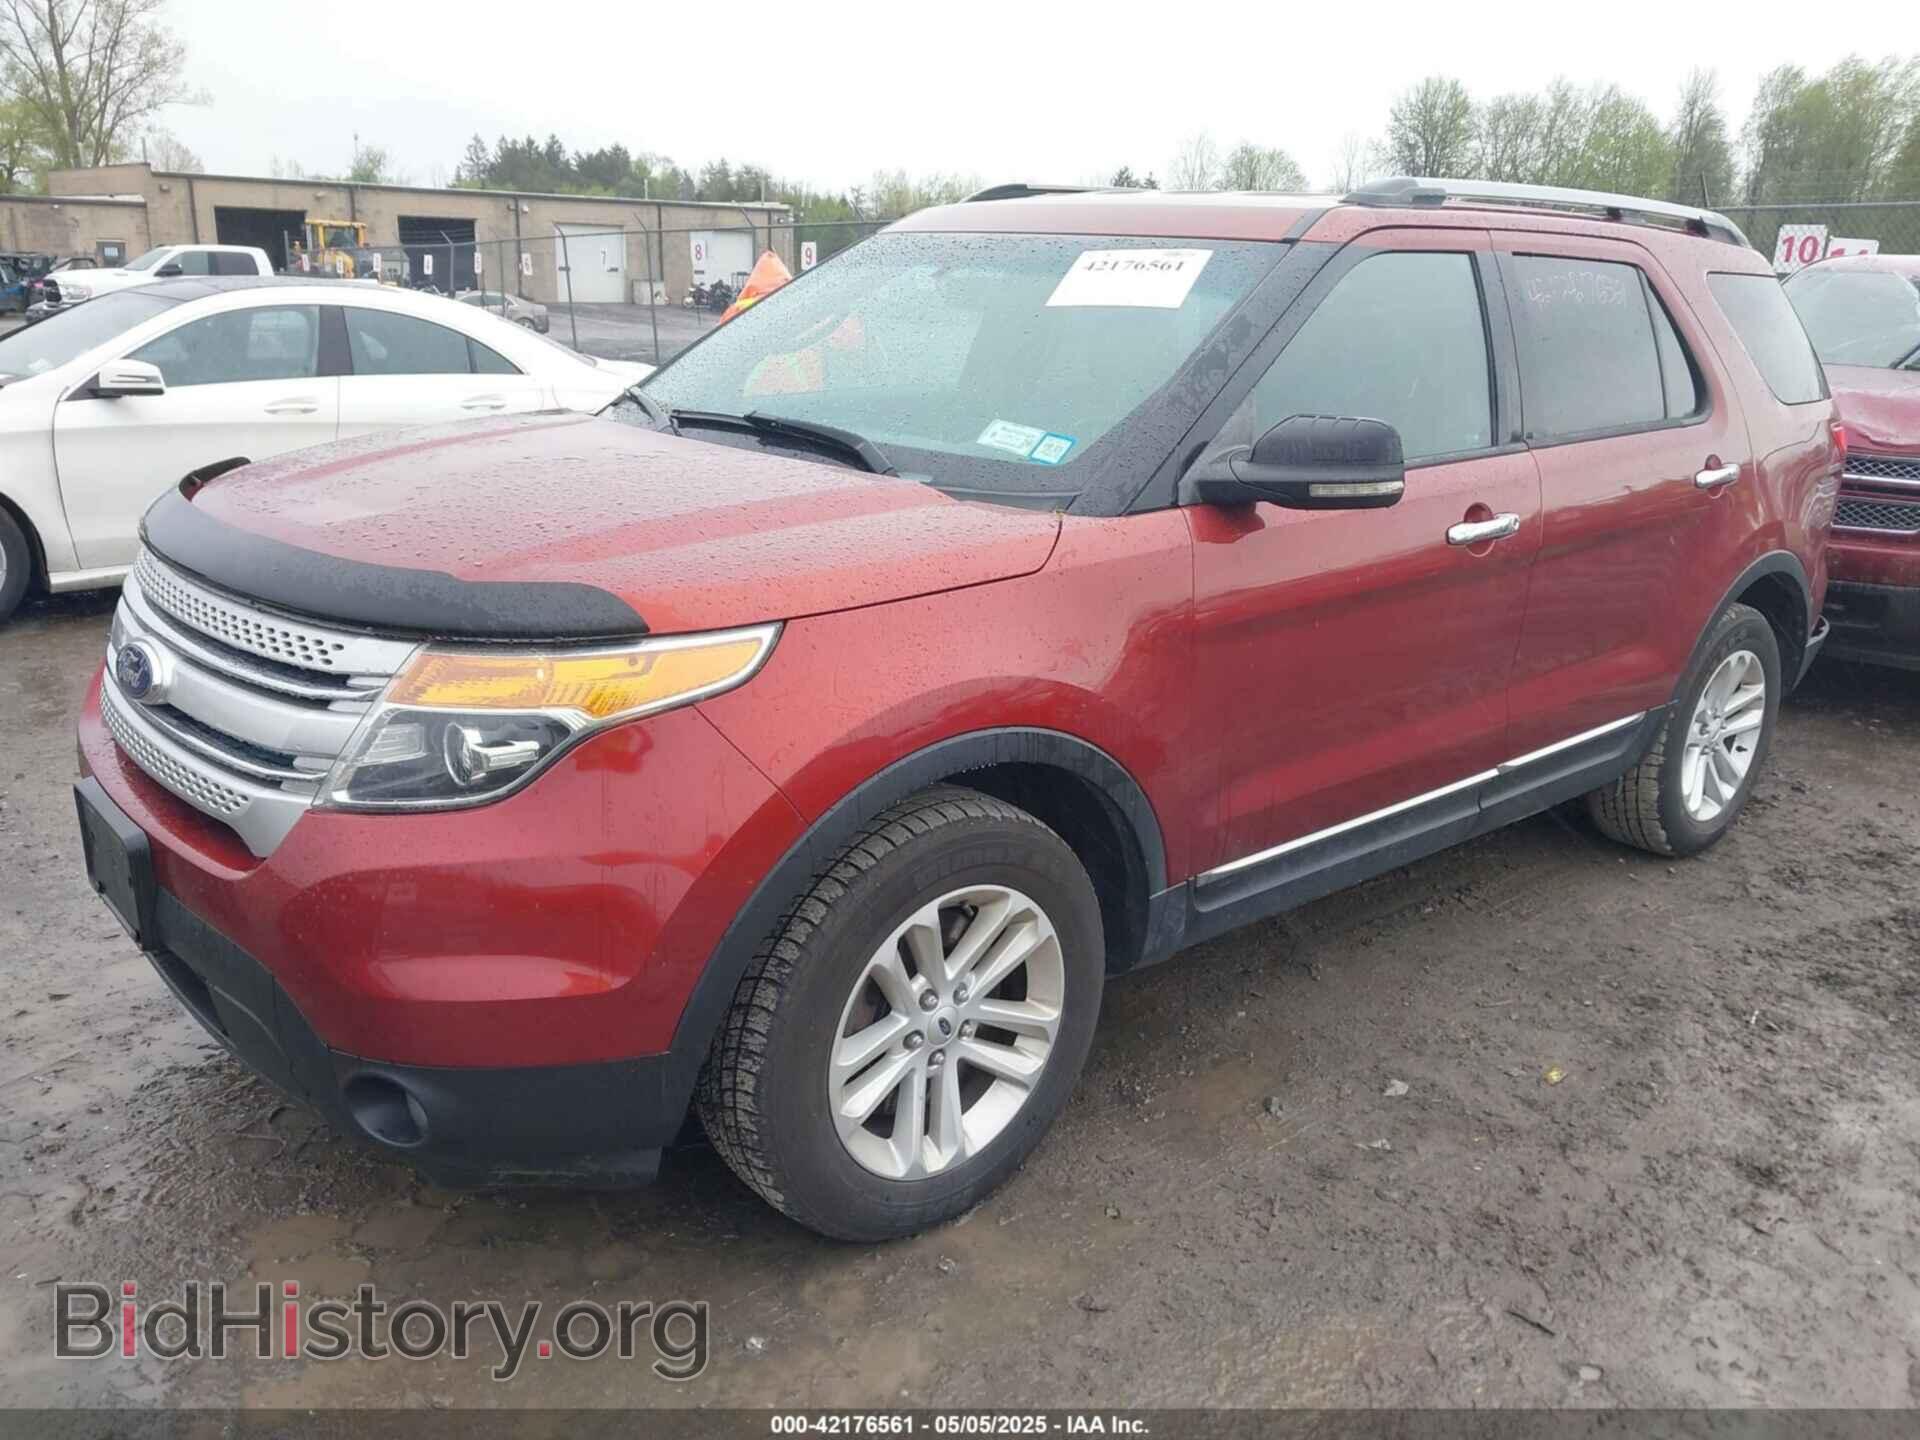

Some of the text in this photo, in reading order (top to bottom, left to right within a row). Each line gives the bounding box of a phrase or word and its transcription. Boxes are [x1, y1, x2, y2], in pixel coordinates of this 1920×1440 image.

[695, 244, 702, 261] 8
[804, 247, 812, 265] 9
[1782, 235, 1819, 264] 10
